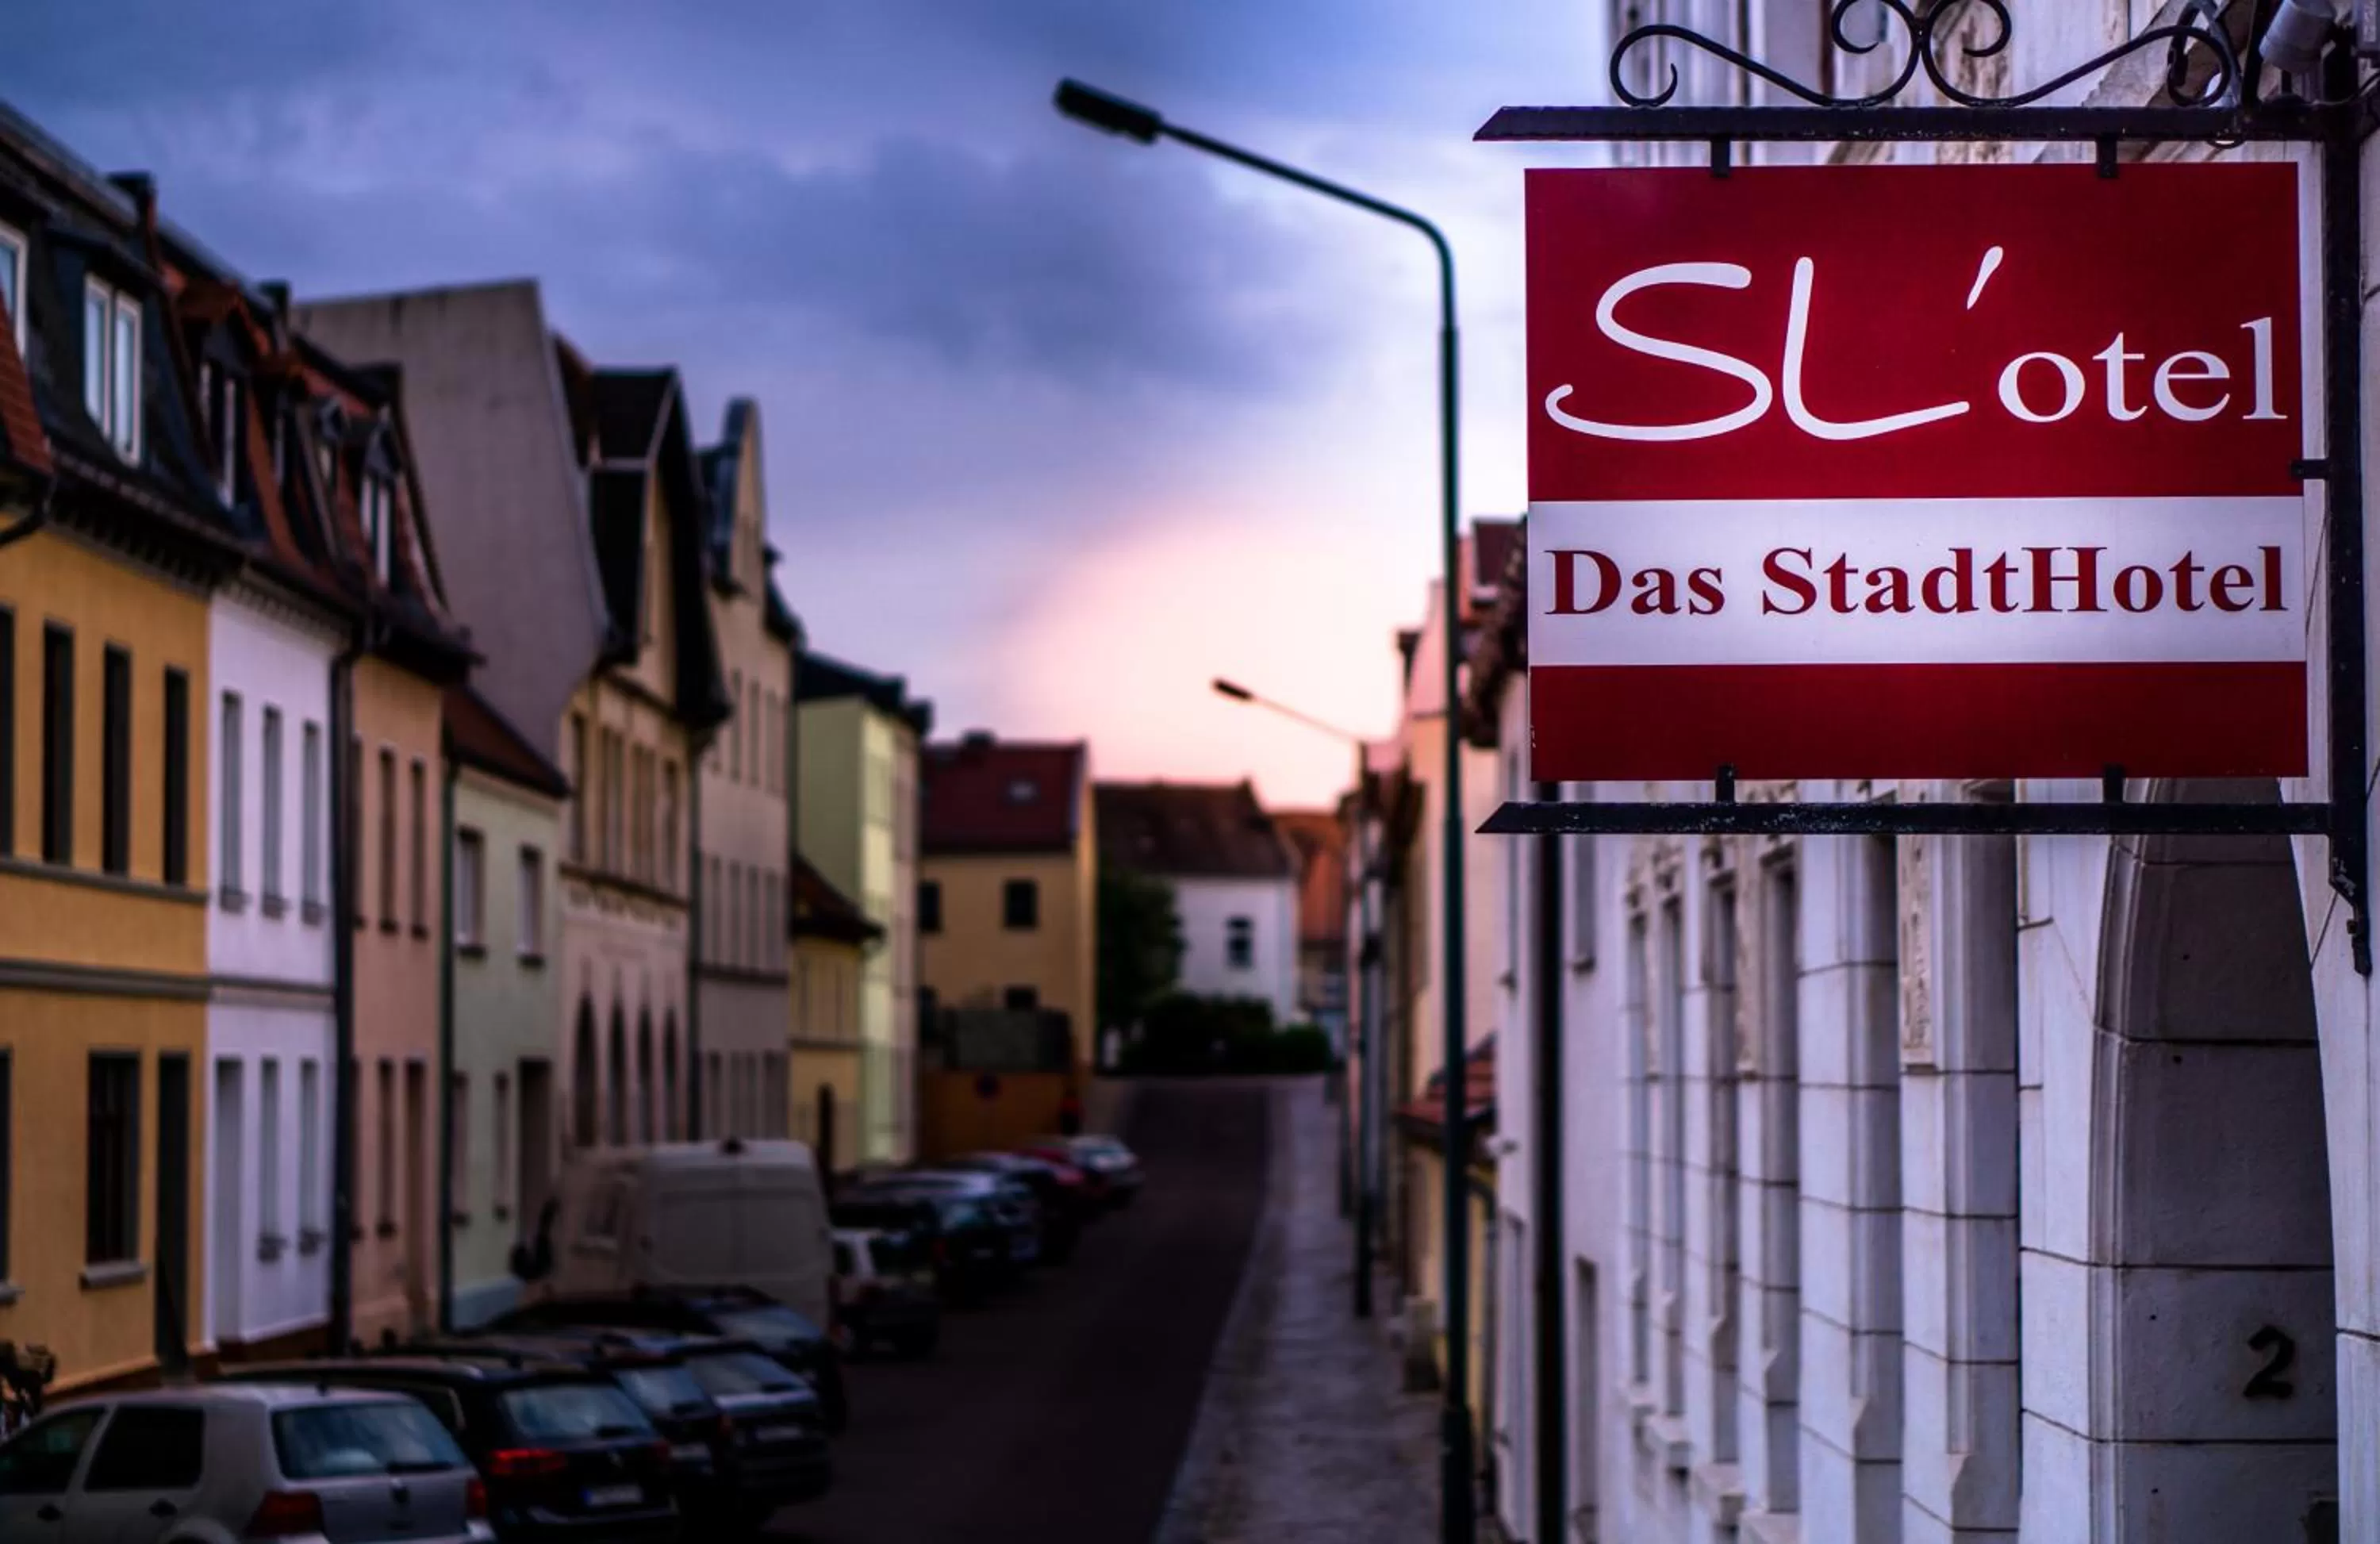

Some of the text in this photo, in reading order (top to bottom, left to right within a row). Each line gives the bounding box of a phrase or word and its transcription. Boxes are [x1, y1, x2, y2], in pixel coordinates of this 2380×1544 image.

[1544, 546, 2288, 615] Das StadtHotel
[2243, 1324, 2296, 1399] 2
